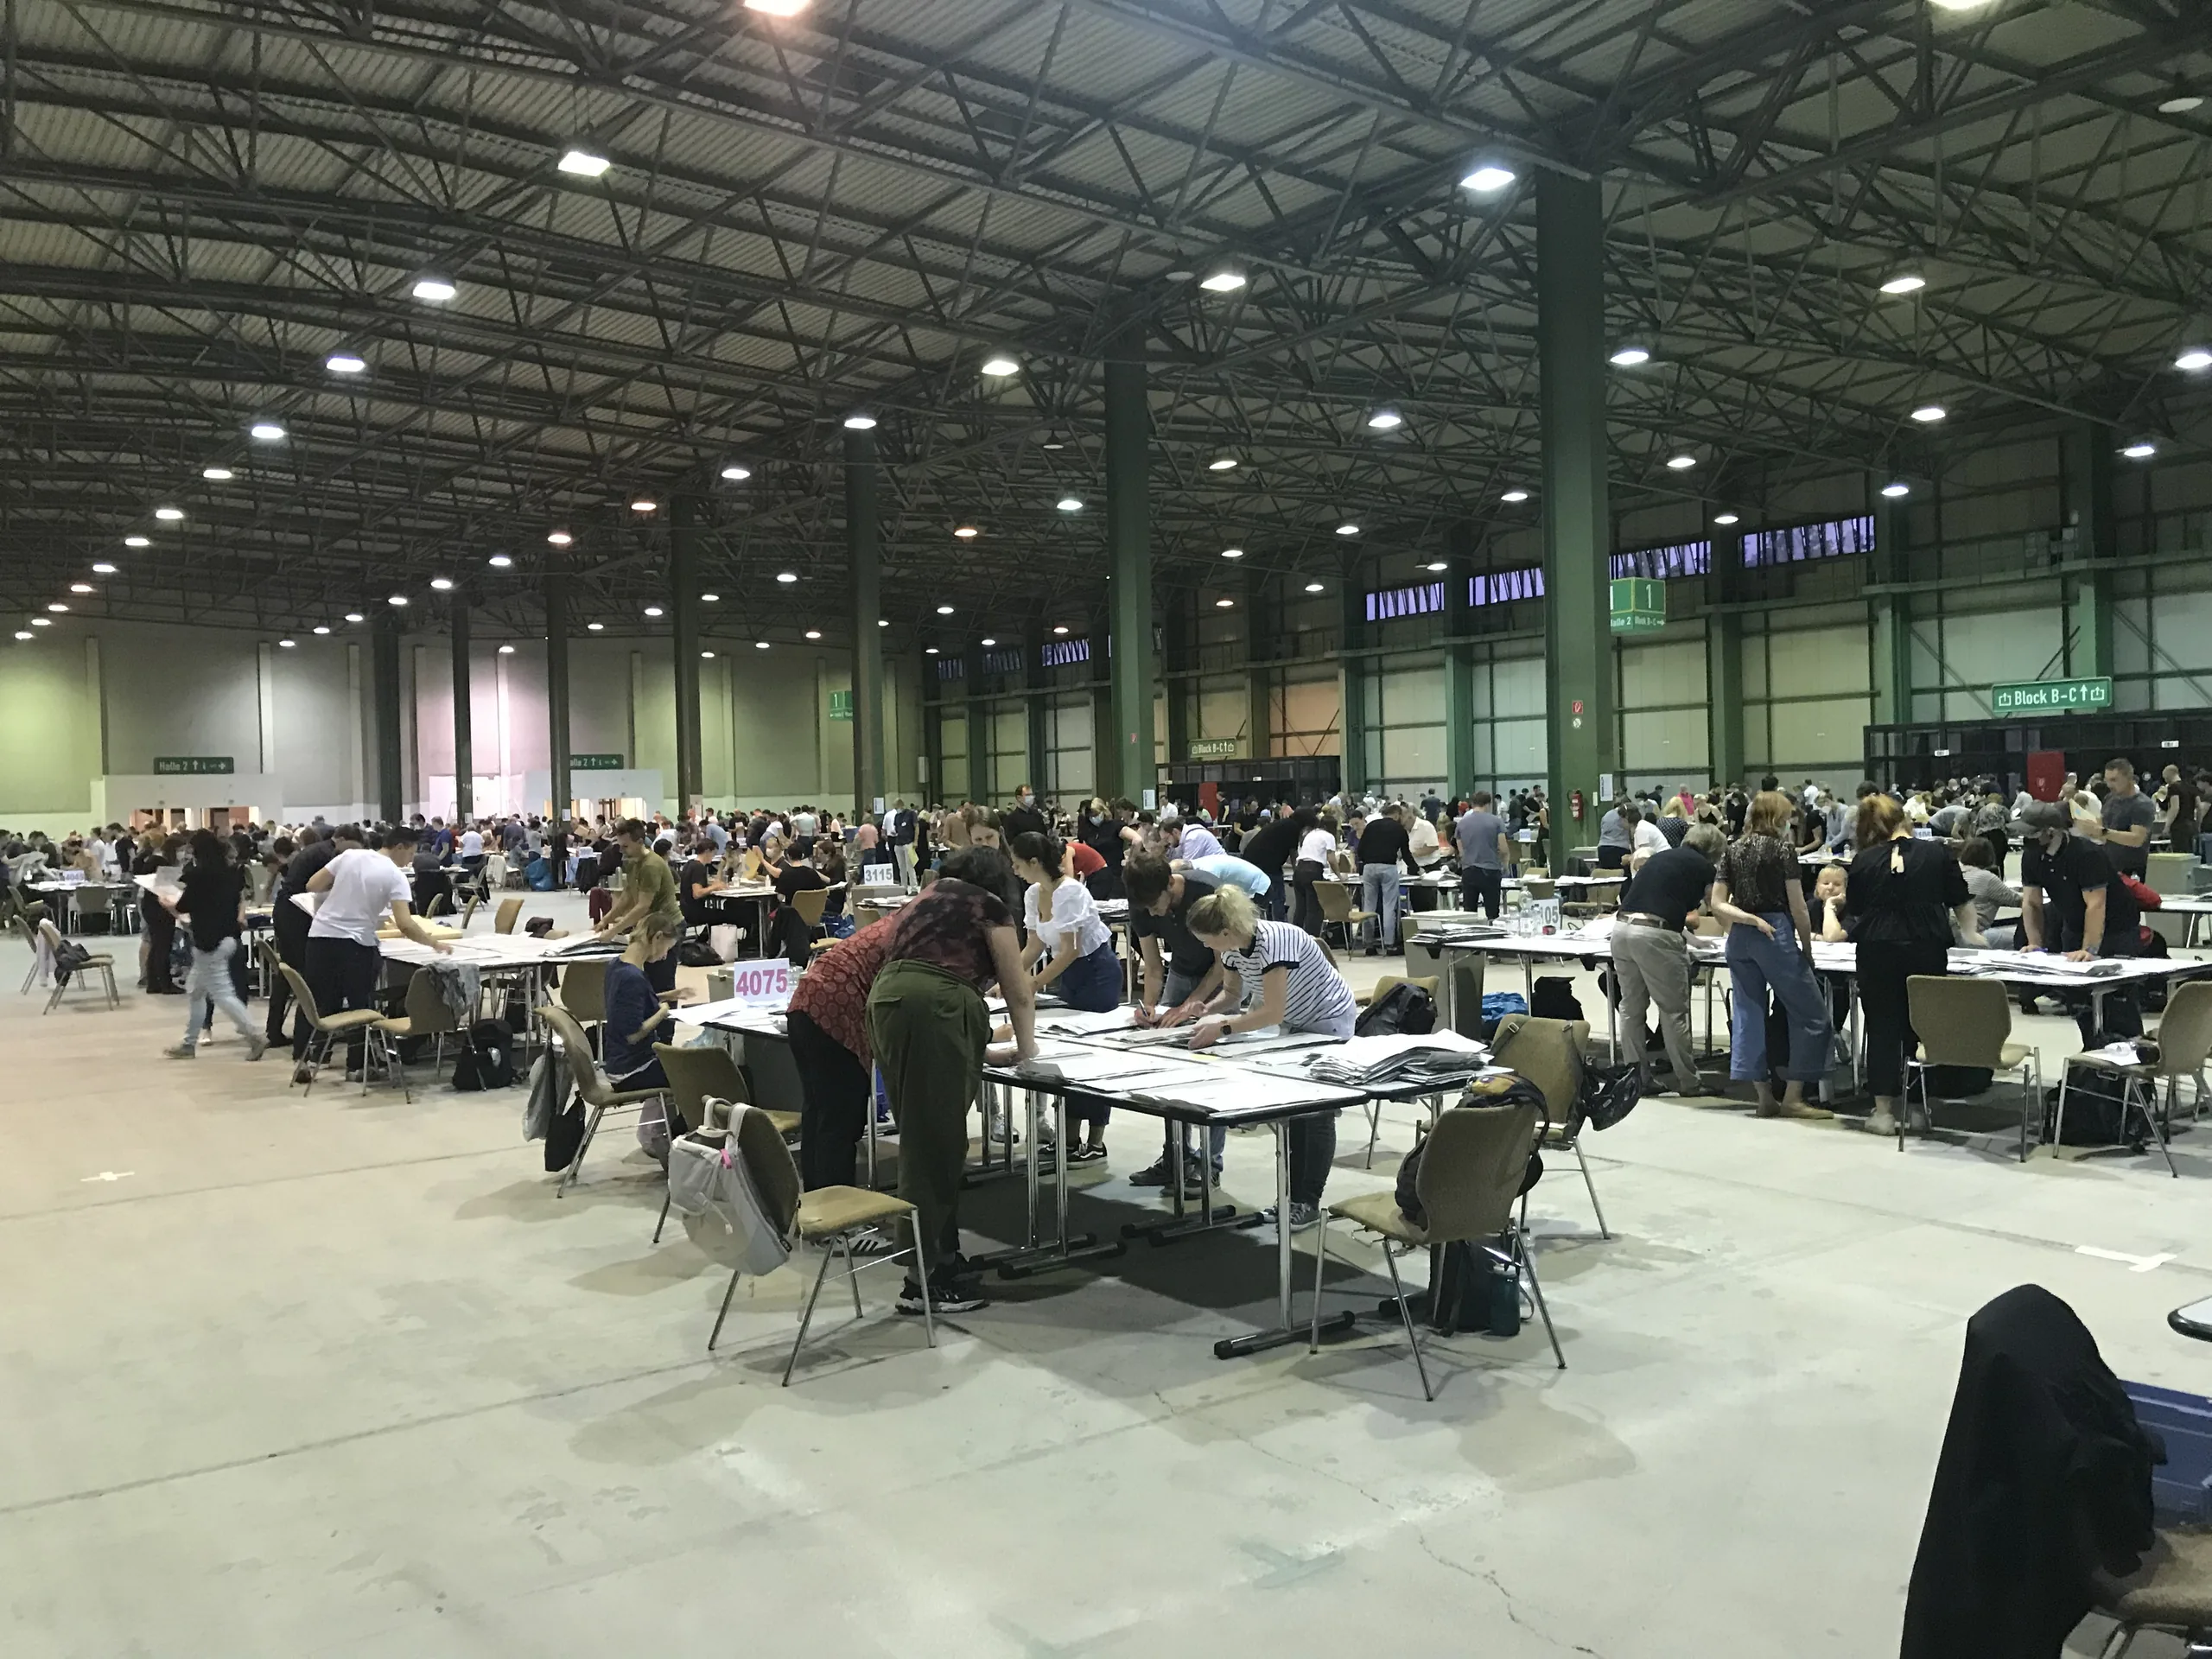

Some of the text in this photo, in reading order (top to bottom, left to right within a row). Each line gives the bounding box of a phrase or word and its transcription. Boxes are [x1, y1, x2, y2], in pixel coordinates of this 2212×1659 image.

[1646, 584, 1651, 608] 1
[1626, 616, 1631, 626] 2
[2014, 687, 2077, 706] Block B-C
[182, 760, 188, 771] 2
[583, 758, 588, 767] 2
[865, 868, 893, 881] 3115
[735, 968, 788, 996] 4075
